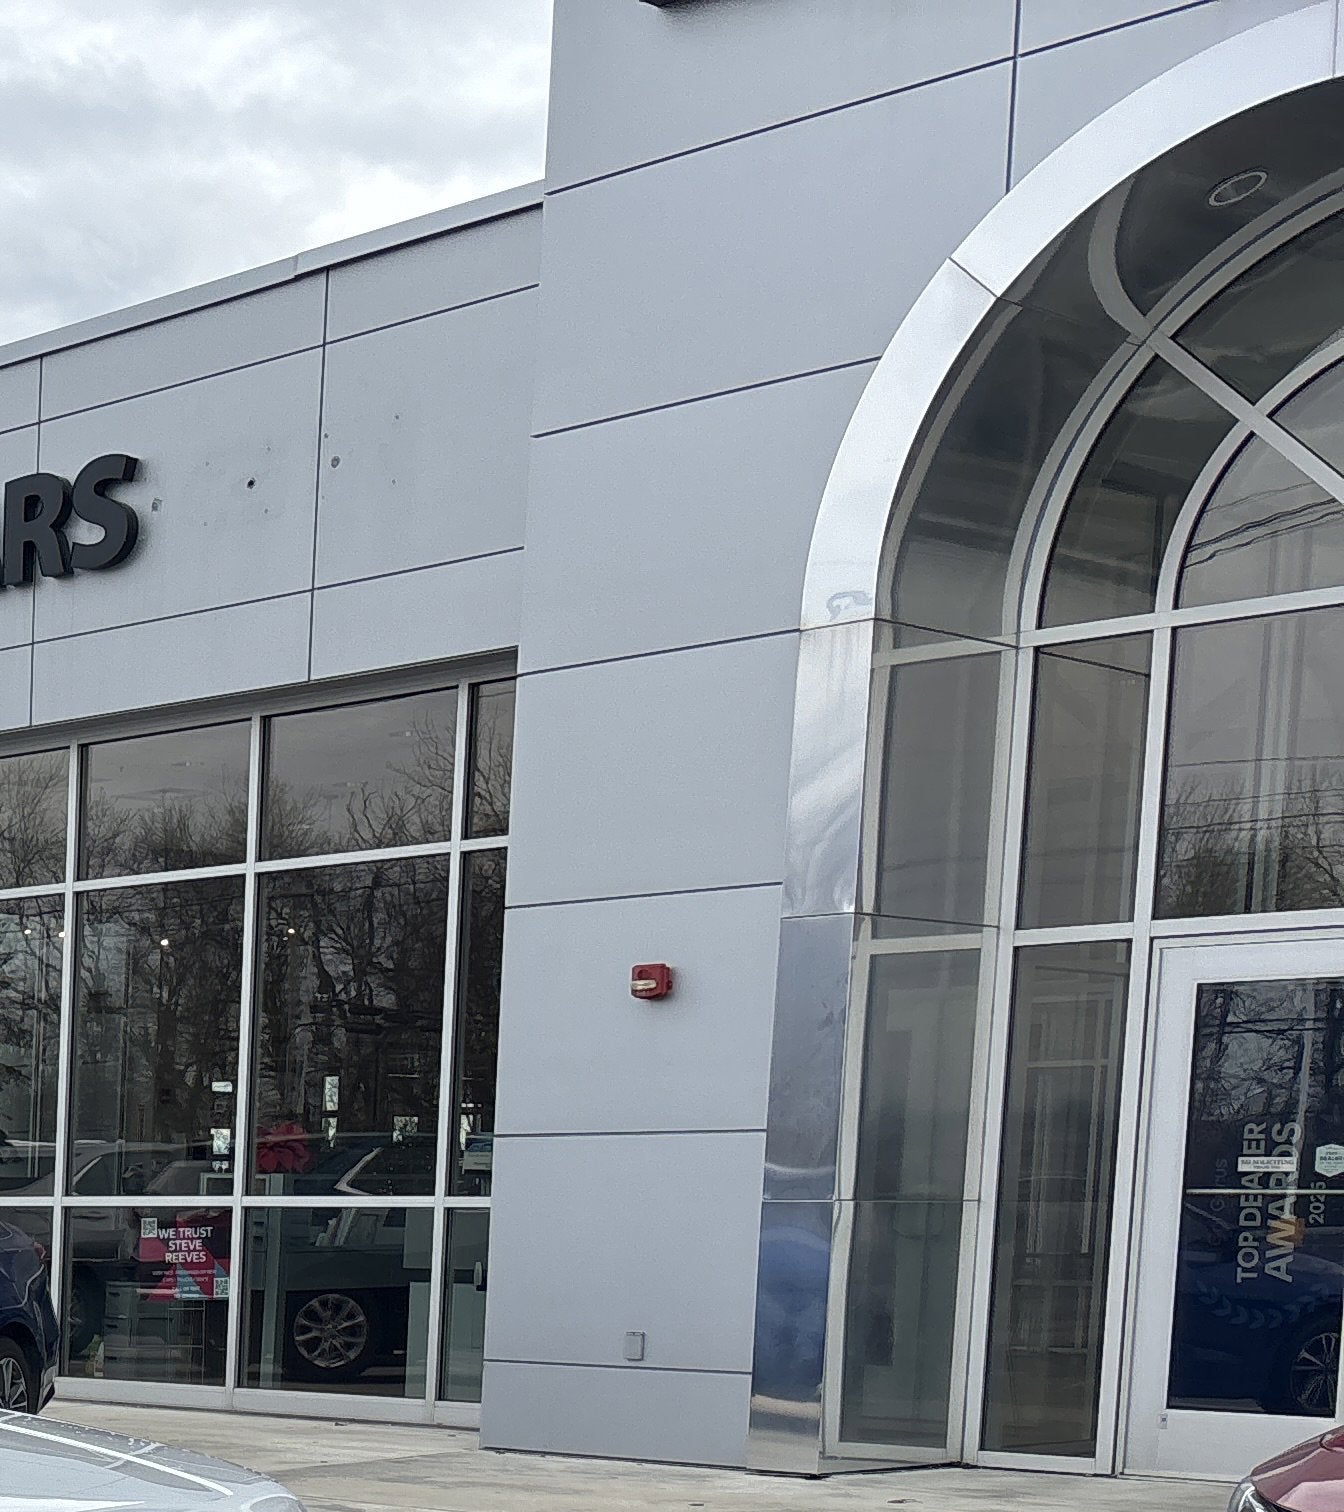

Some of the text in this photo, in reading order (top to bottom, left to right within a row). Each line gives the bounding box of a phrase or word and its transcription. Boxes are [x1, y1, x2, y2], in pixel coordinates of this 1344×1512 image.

[1238, 1122, 1267, 1227] DEAER
[158, 1226, 213, 1239] WE TRUST
[168, 1239, 202, 1251] STEVE
[165, 1251, 206, 1263] REEVES
[1236, 1231, 1259, 1283] TOP
